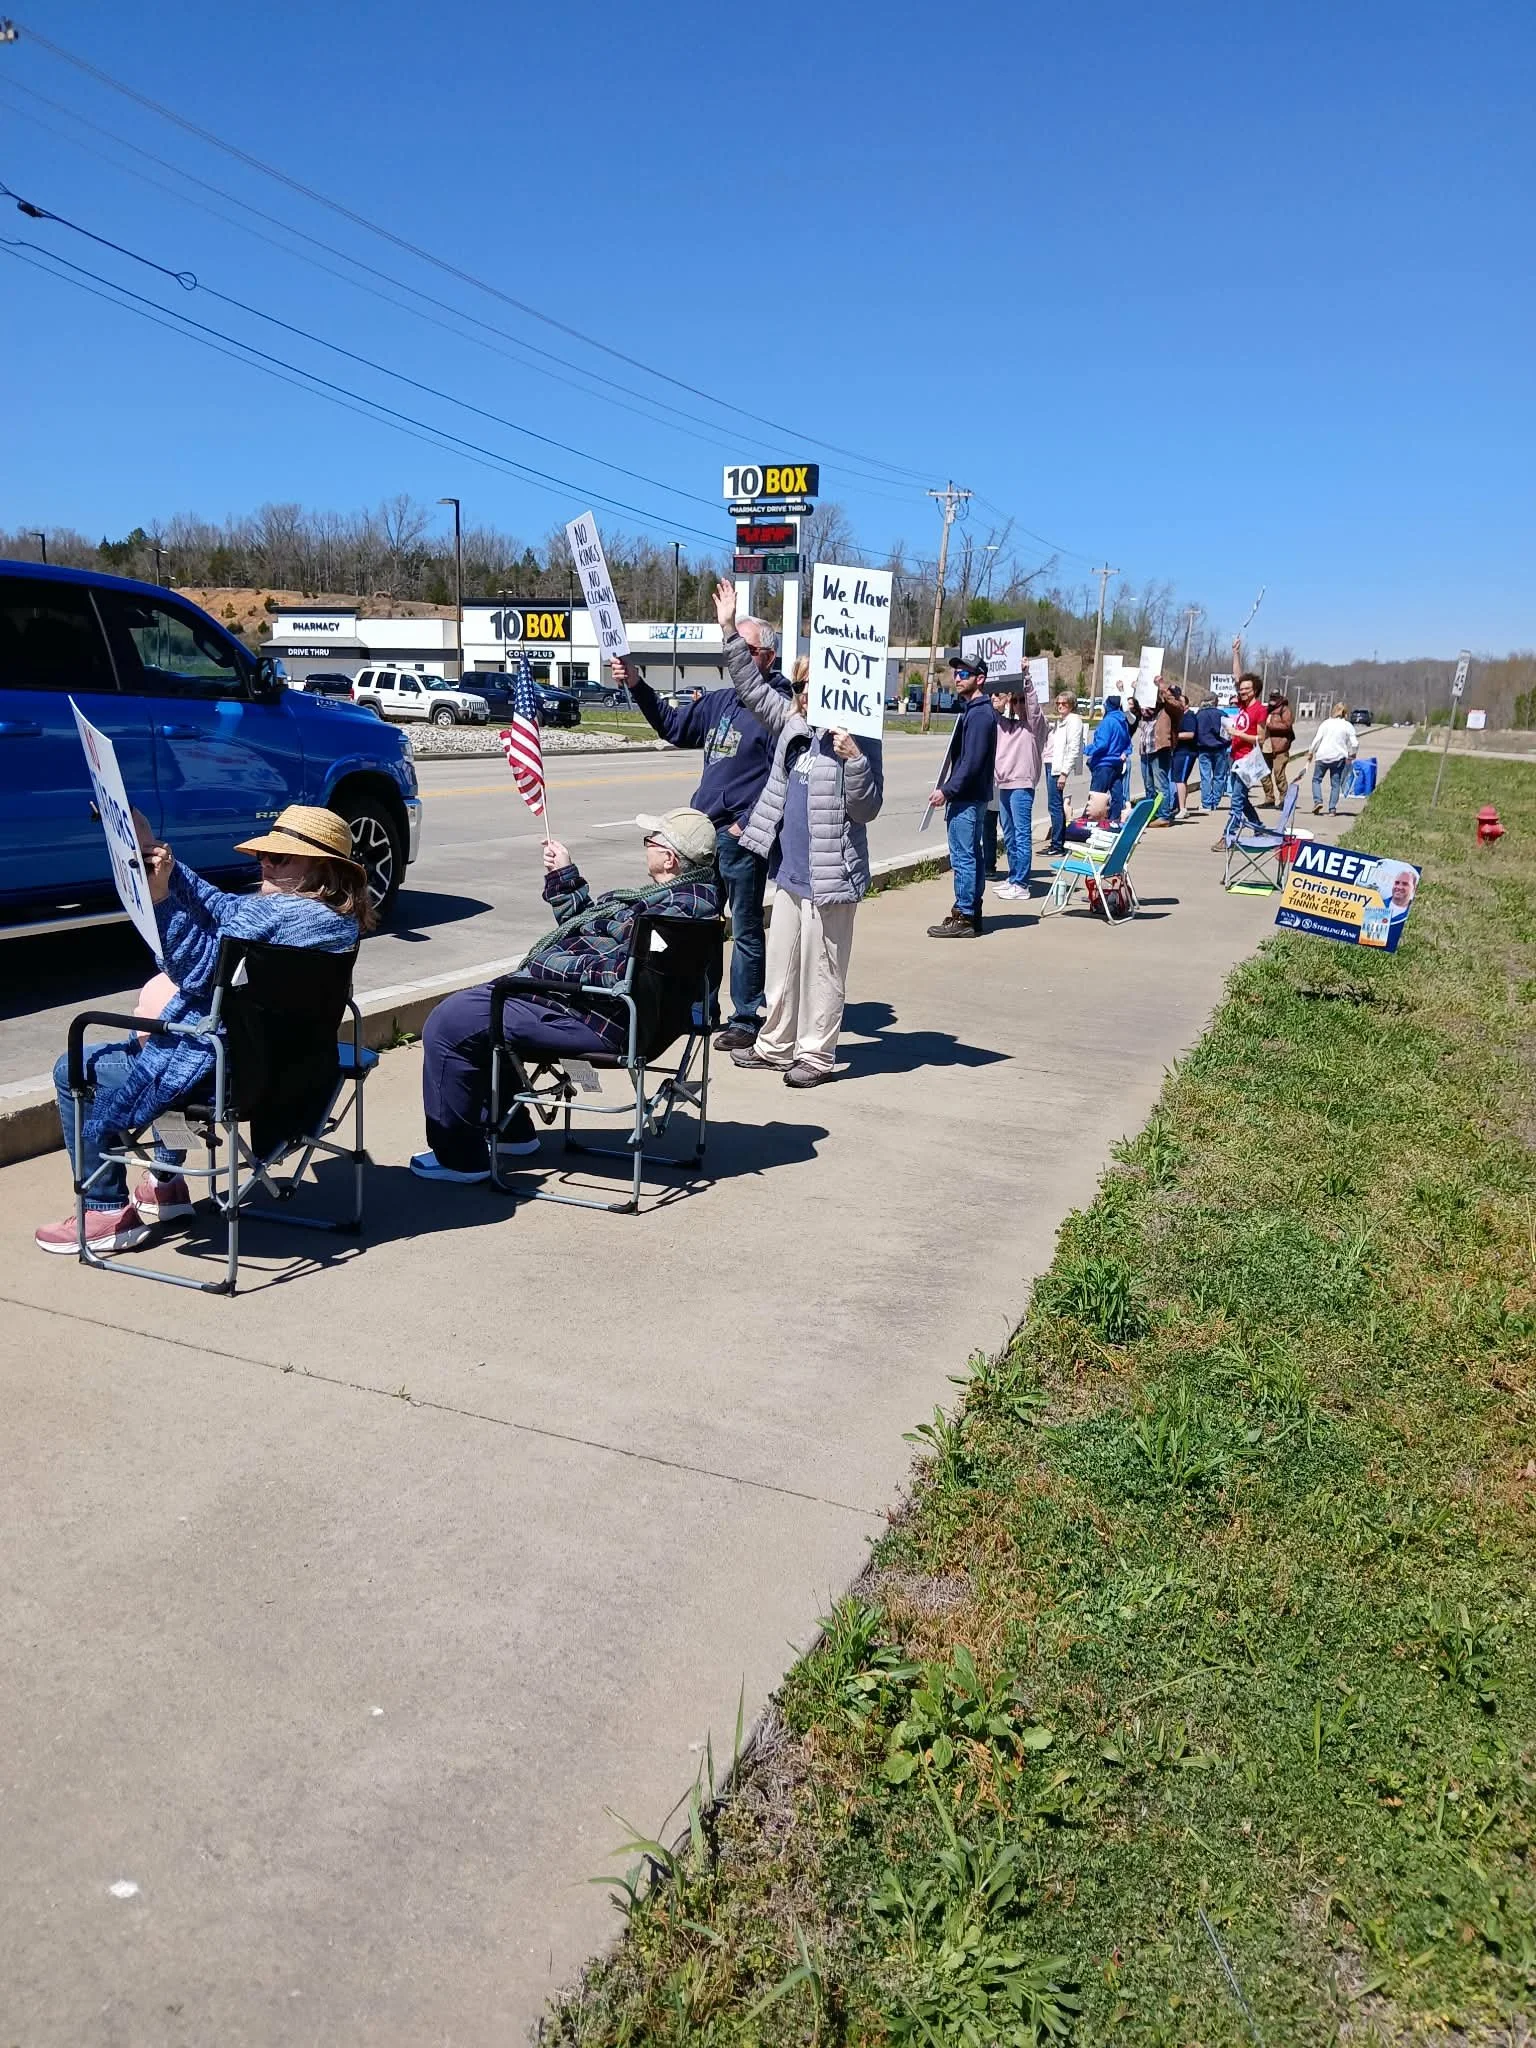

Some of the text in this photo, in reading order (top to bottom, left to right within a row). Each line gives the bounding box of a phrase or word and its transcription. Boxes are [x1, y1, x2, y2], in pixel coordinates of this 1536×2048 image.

[728, 467, 808, 496] 10 BOX
[729, 504, 807, 514] PHARMACY DRIVE THRU
[574, 523, 587, 546] NO
[578, 544, 601, 567] KINGS
[588, 571, 600, 589] NO
[822, 574, 889, 608] We Have
[490, 610, 566, 640] 10 BOX
[599, 609, 611, 629] NO
[840, 608, 855, 619] a
[293, 622, 340, 631] PHARMACY
[814, 614, 887, 648] Constitution
[602, 629, 622, 648] CONS
[976, 637, 994, 660] NO
[287, 648, 330, 656] DRIVE THRU
[842, 678, 851, 686] a
[1294, 845, 1378, 883] MEET
[1292, 877, 1373, 908] Chris Henry
[1300, 892, 1316, 902] PM
[1322, 897, 1341, 908] APR
[1342, 902, 1350, 910] 7
[1288, 897, 1357, 920] TINNIN CENTER
